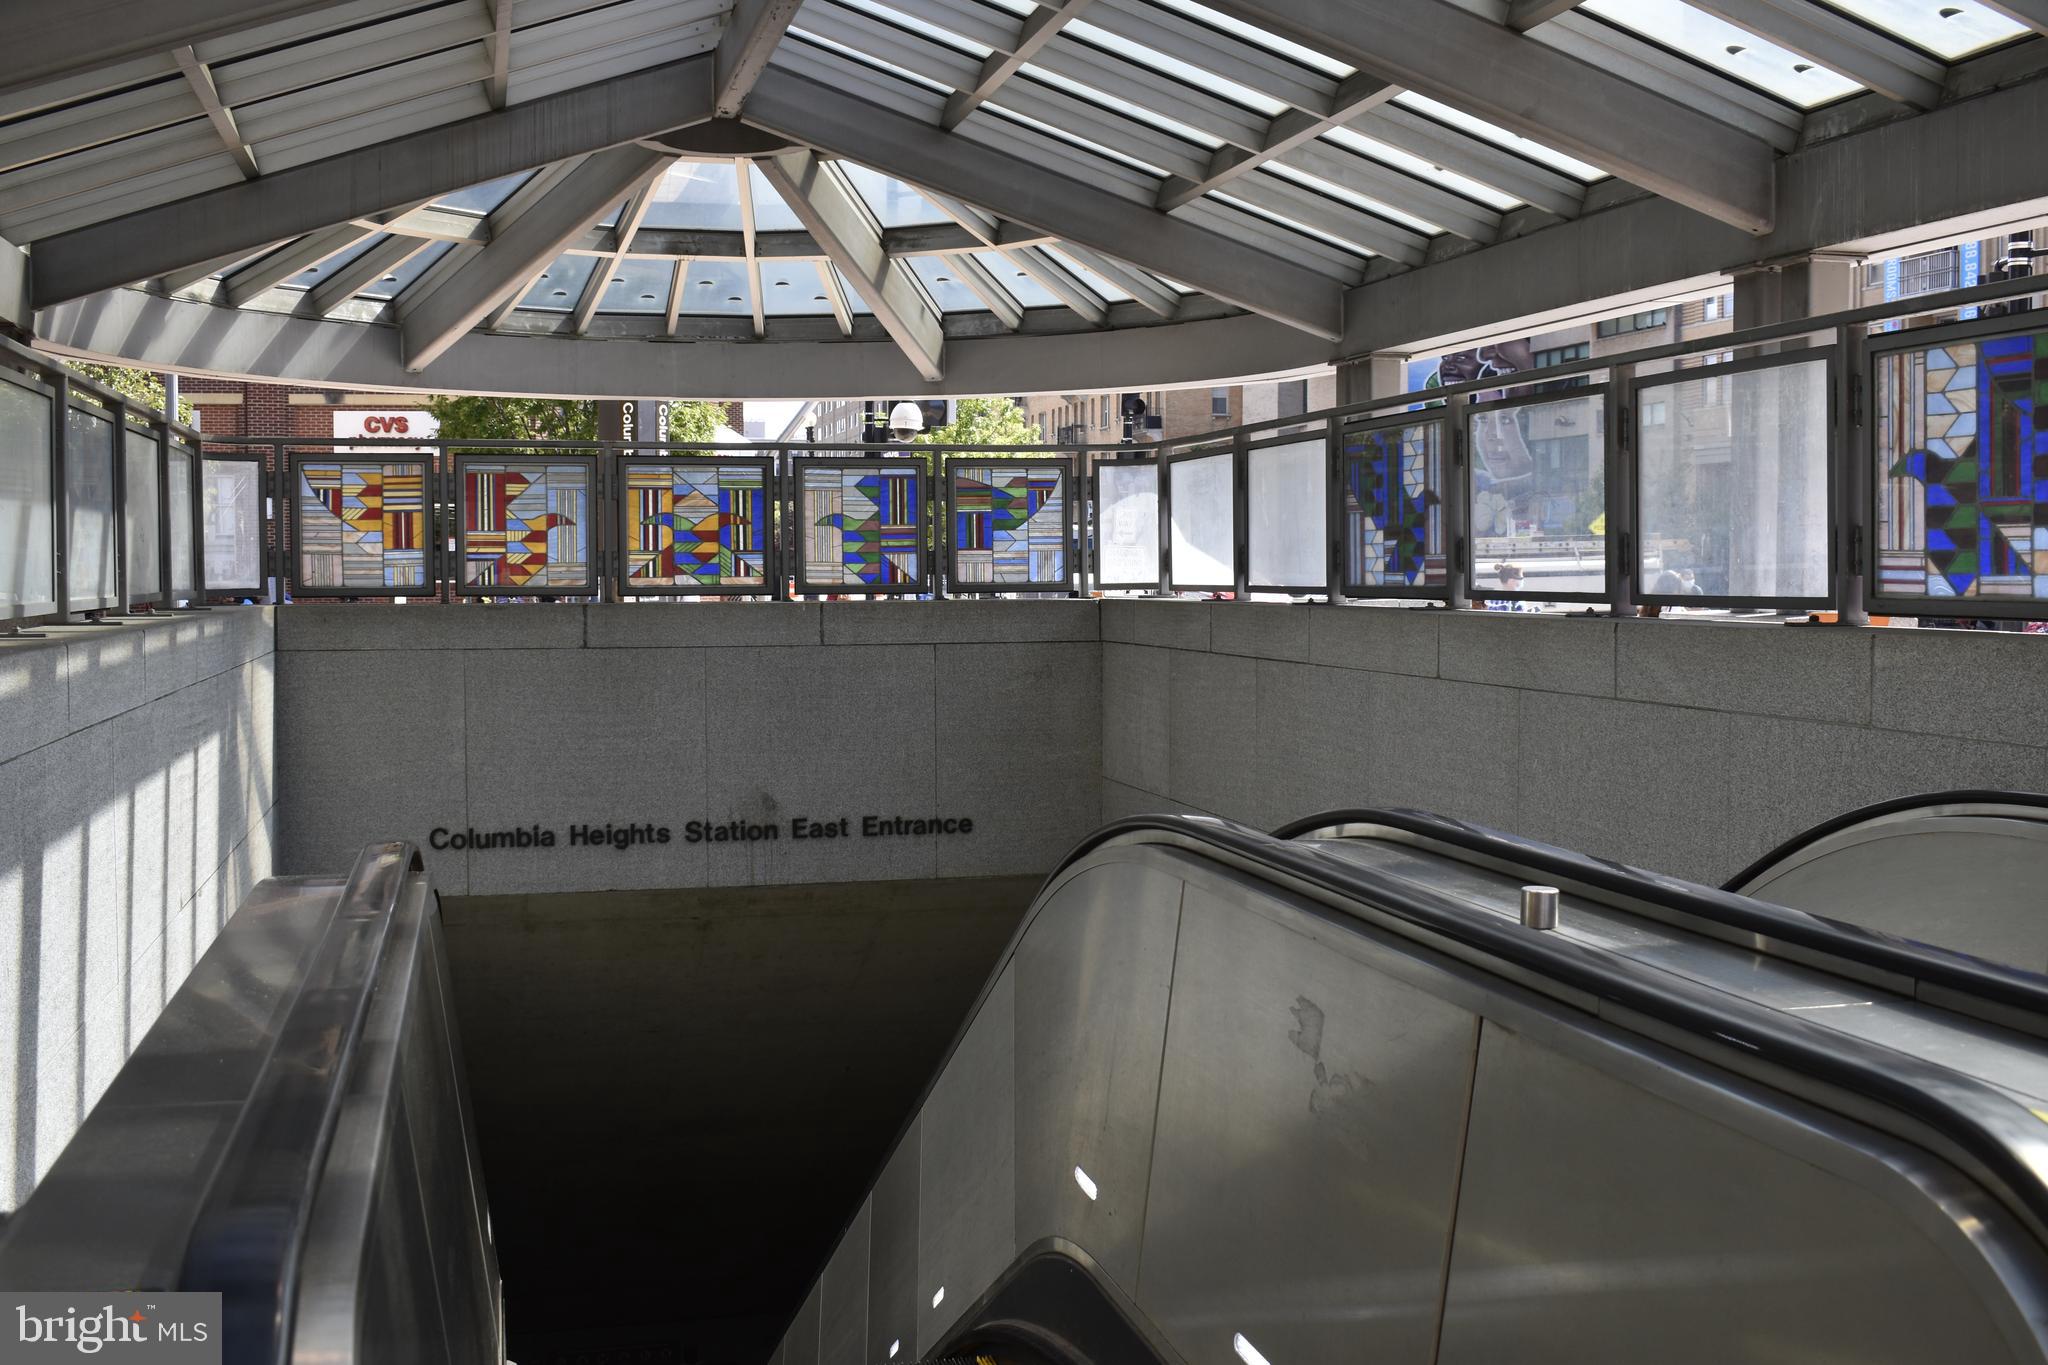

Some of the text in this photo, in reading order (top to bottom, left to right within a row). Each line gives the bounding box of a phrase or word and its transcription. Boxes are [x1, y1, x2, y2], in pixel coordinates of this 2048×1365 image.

[364, 416, 409, 433] CVS
[429, 815, 973, 850] Columbia Heights Station East Entrance
